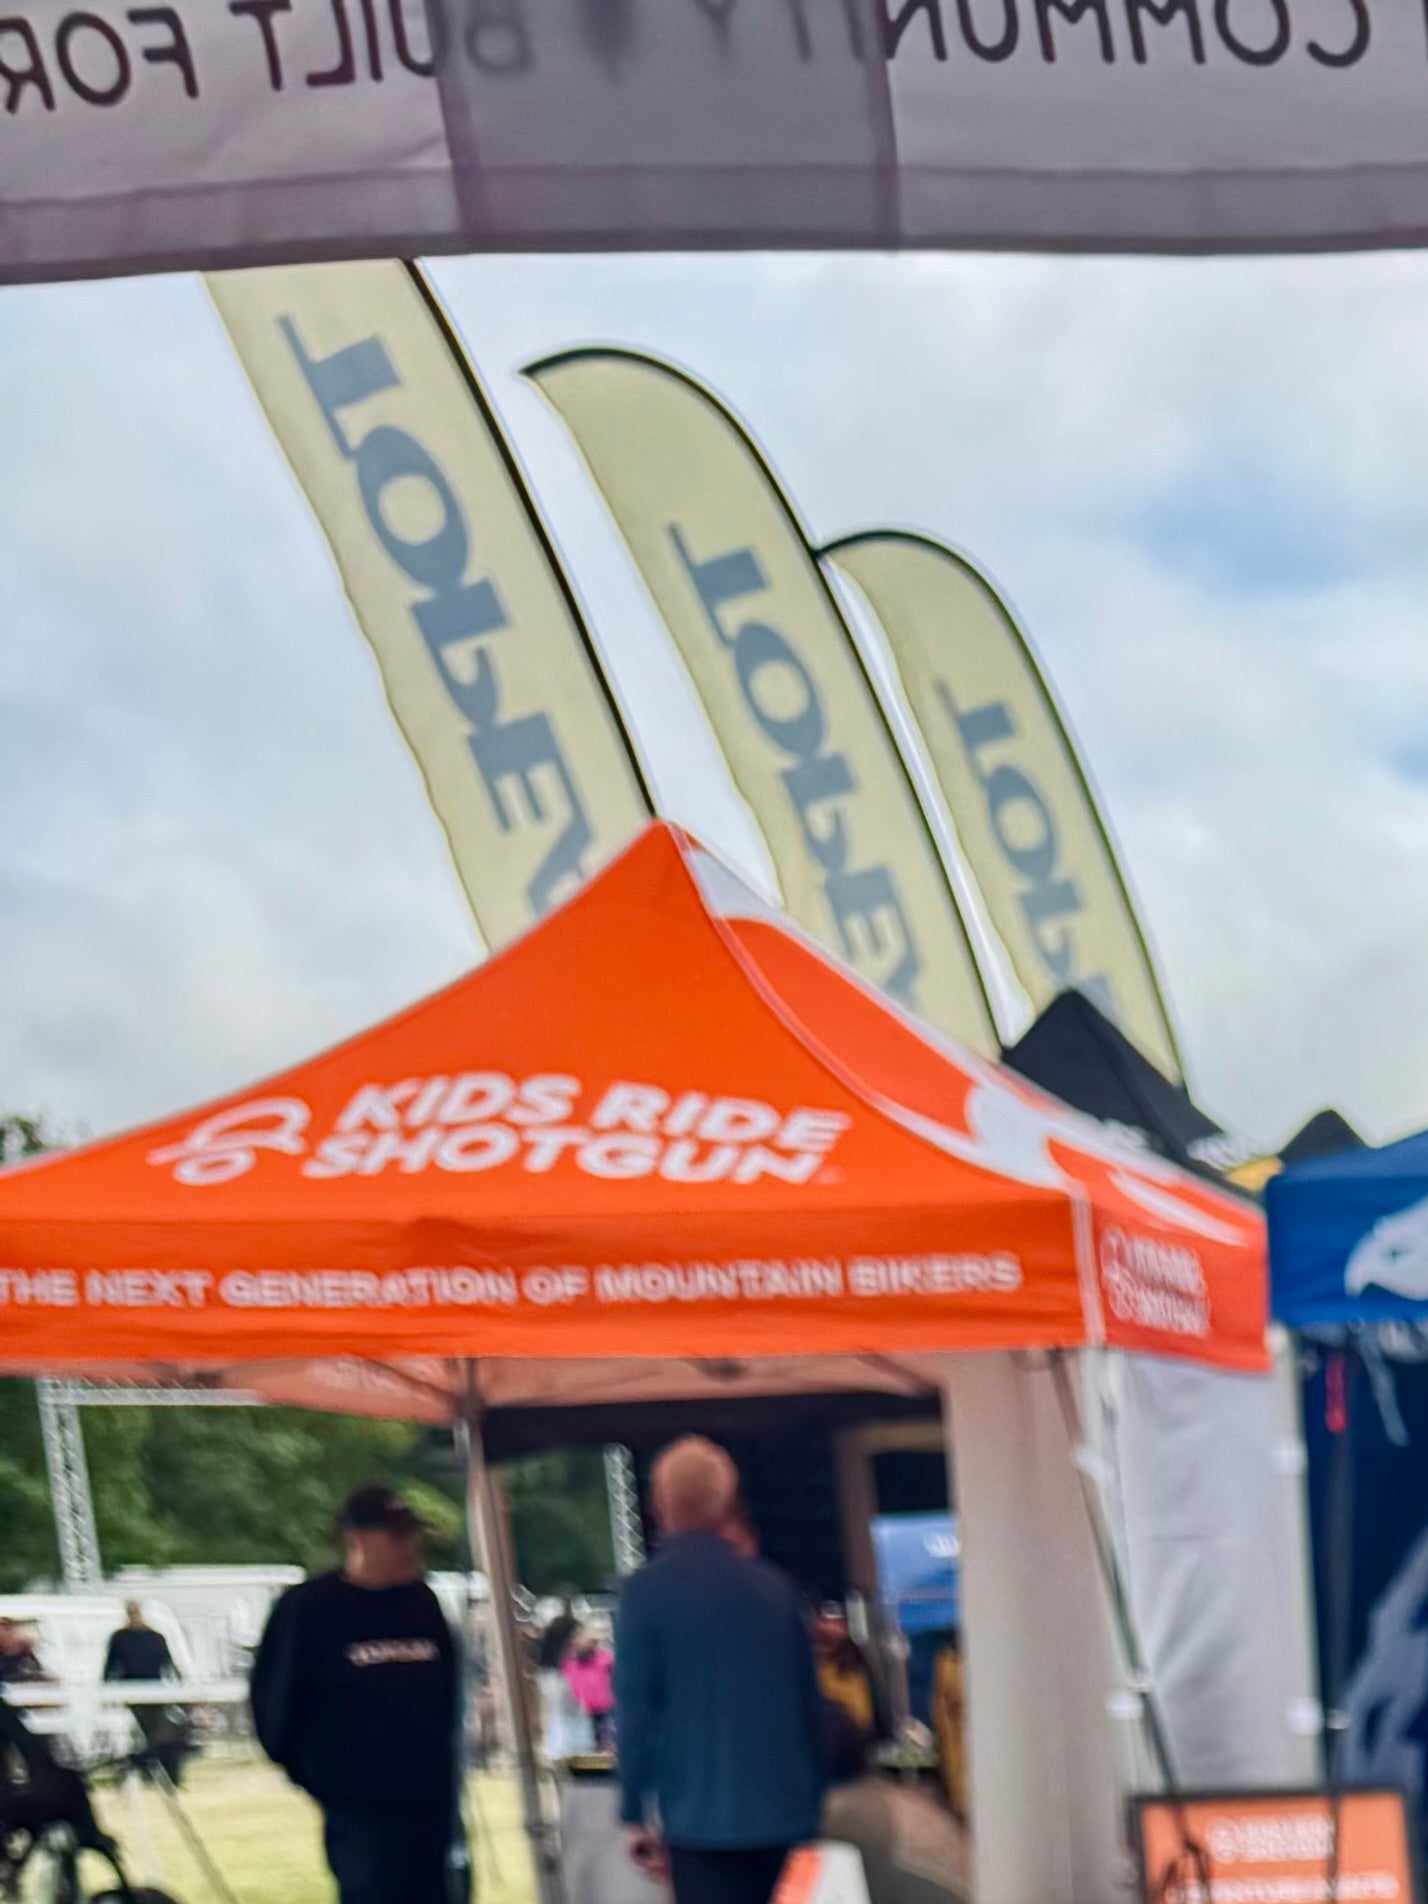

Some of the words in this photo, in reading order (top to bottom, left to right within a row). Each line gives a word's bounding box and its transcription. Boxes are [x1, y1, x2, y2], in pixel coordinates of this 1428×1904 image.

[337, 1072, 581, 1131] KIDS
[592, 1080, 853, 1151] RIDE
[300, 1123, 826, 1184] SHOTGUN
[0, 1267, 79, 1307] THE
[85, 1267, 214, 1308] NEXT
[219, 1265, 519, 1308] GENERATION
[522, 1264, 591, 1305] OF
[595, 1257, 844, 1303] MOUNTAIN
[848, 1250, 1024, 1298] BIKERS
